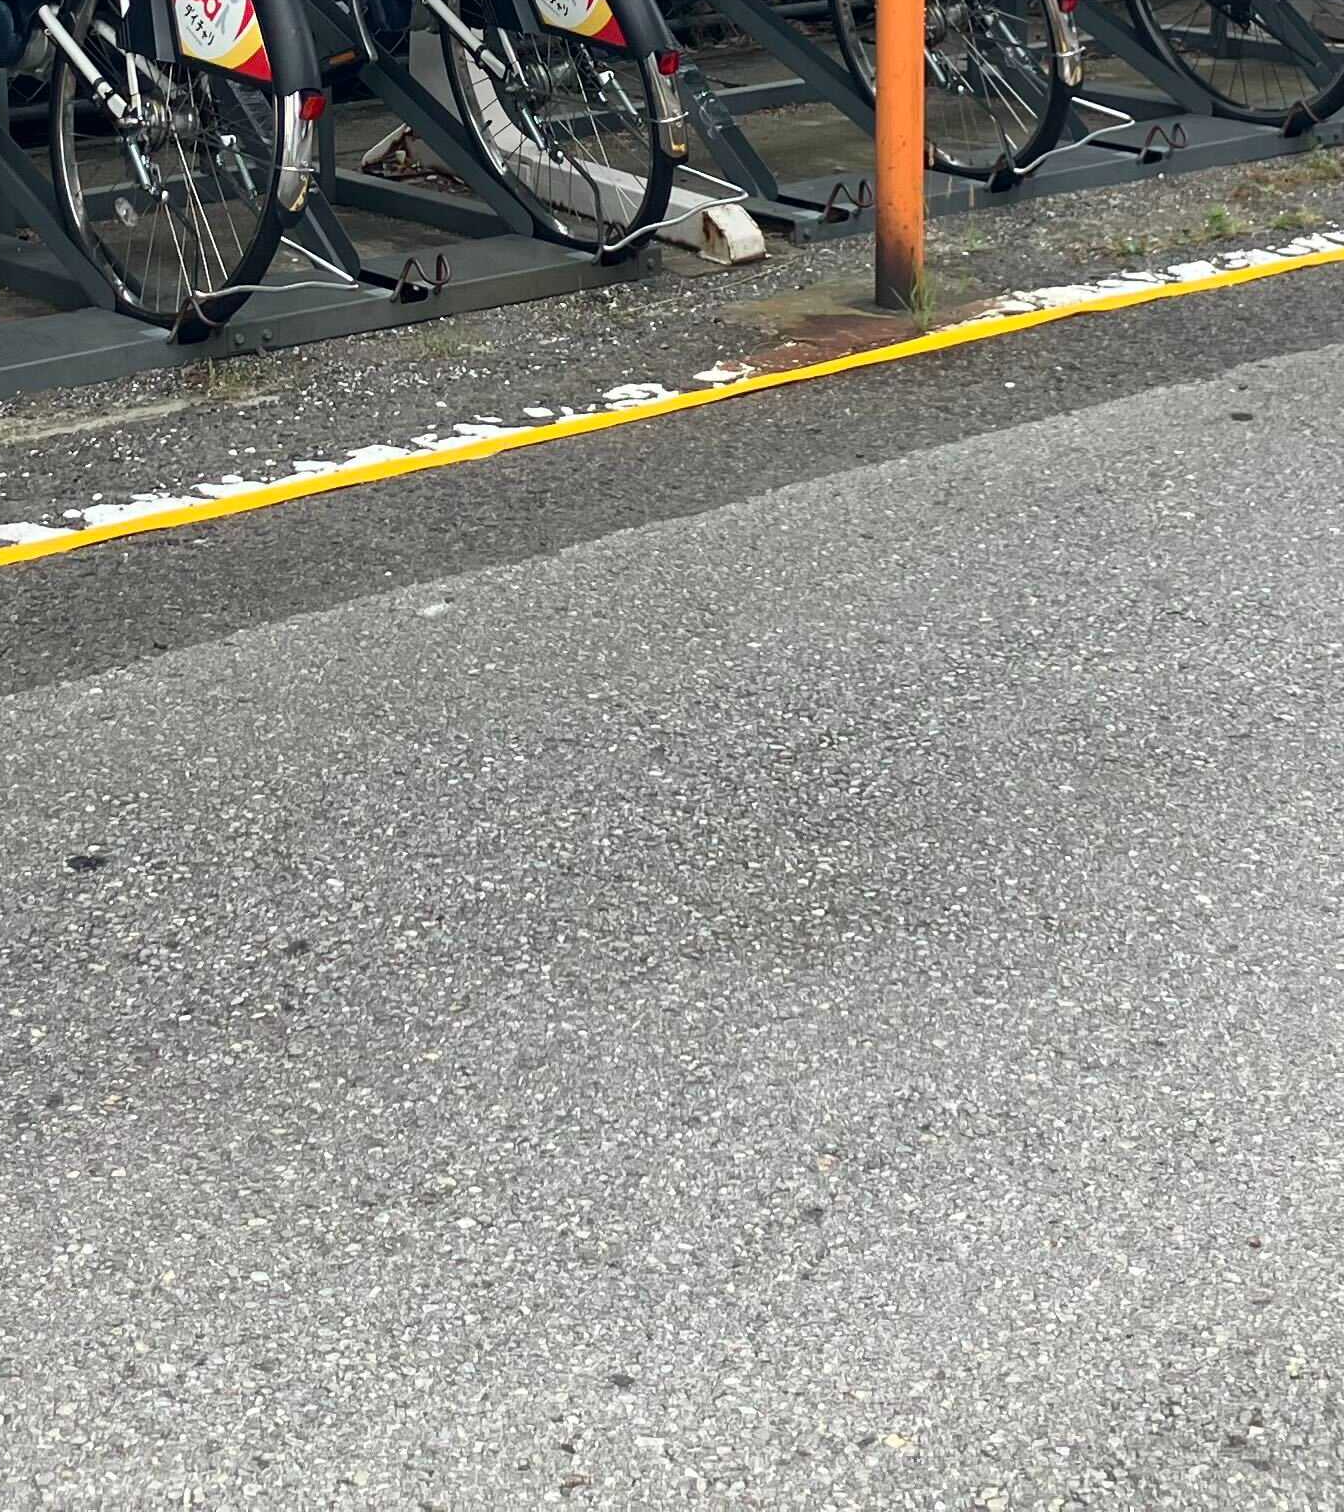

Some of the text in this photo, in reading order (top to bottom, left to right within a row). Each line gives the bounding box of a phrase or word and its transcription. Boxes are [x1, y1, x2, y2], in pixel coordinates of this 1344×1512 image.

[184, 4, 215, 46] ダイチャリ
